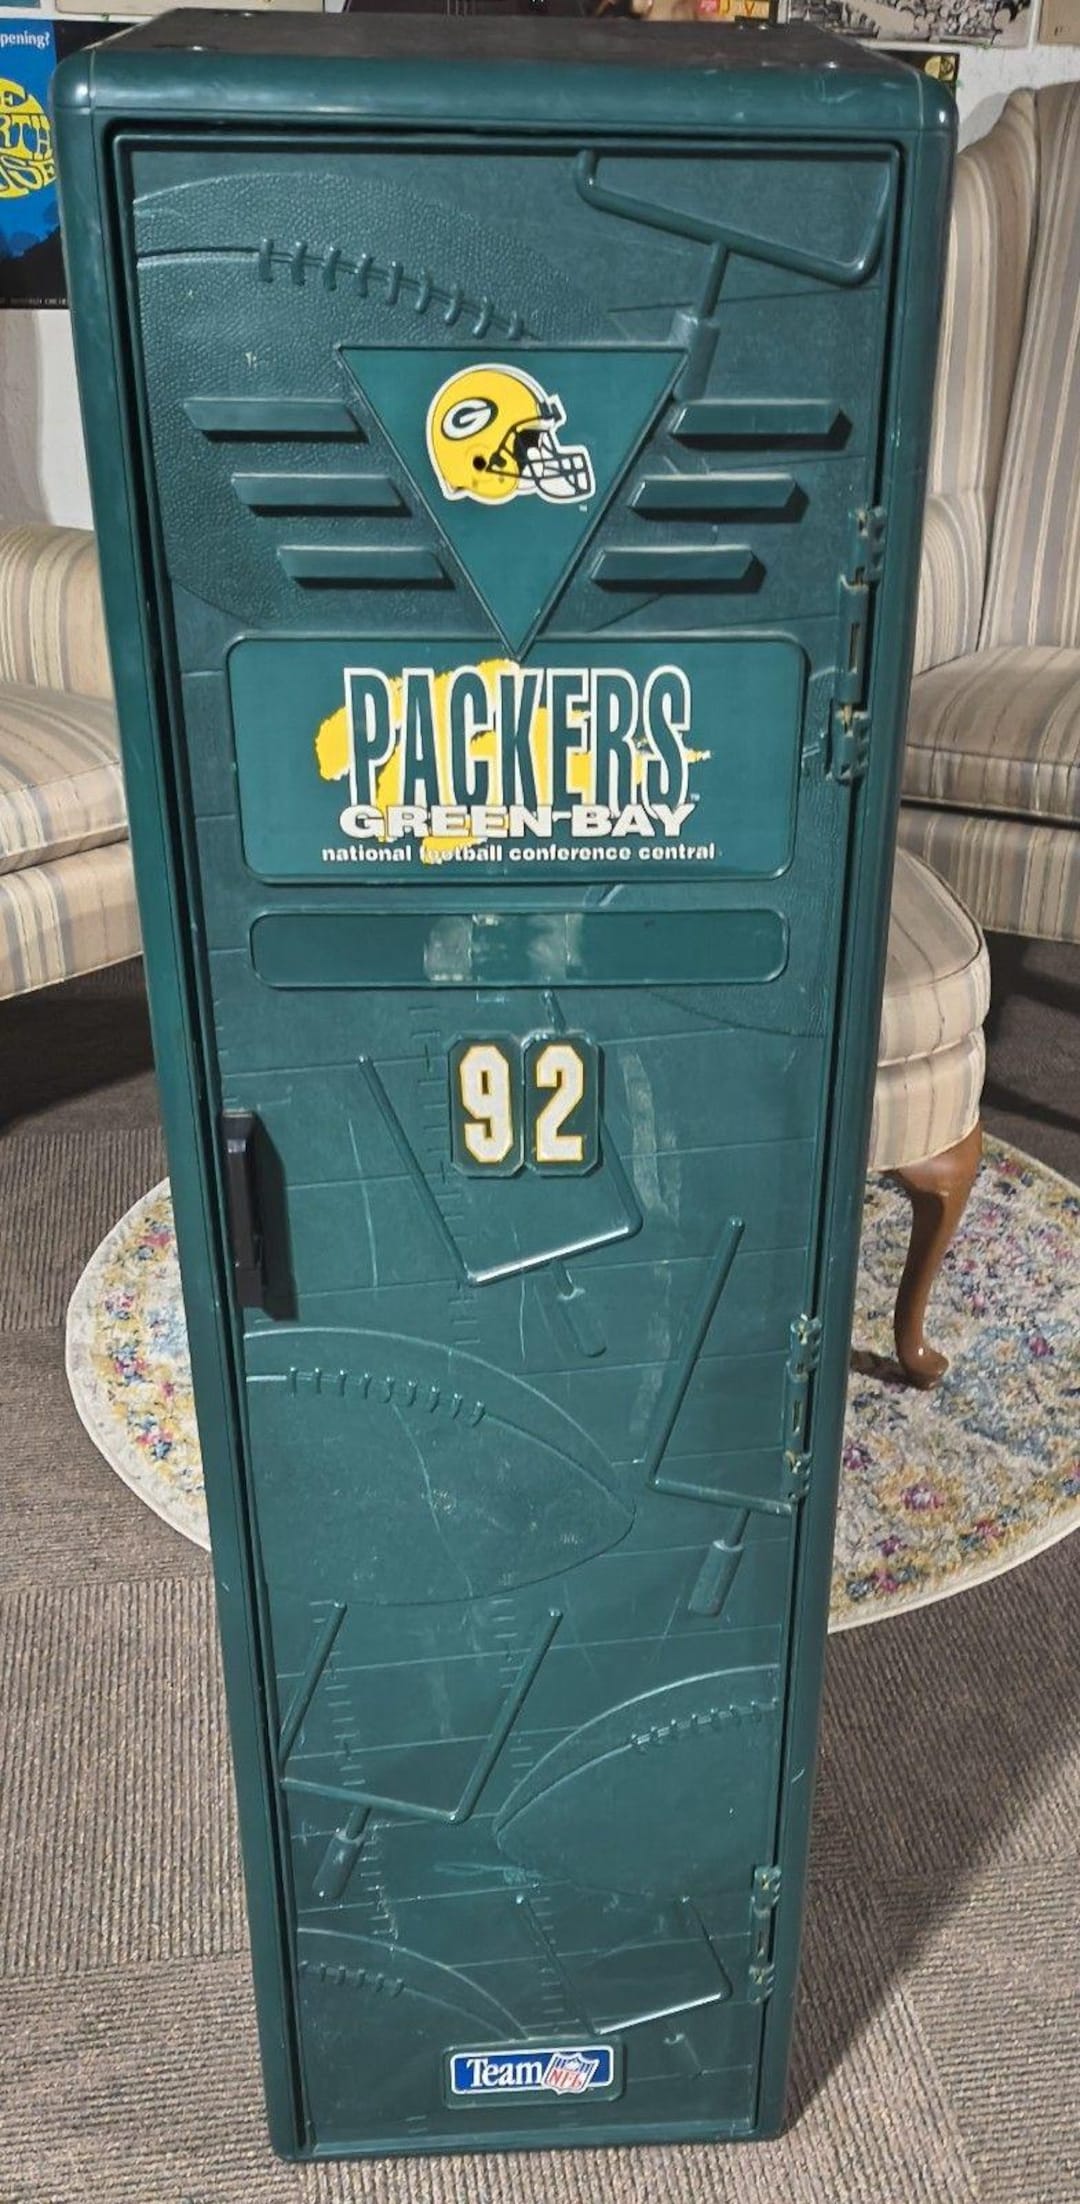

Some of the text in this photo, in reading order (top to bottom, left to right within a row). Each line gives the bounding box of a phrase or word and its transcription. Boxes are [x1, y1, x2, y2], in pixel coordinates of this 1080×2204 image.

[442, 398, 493, 440] G
[344, 664, 692, 820] PACKERS
[340, 804, 695, 838] GREEN BAY
[322, 844, 411, 862] national
[509, 844, 631, 861] conference
[638, 842, 715, 860] central
[459, 1044, 584, 1163] 92
[467, 2057, 583, 2088] Team NFL
